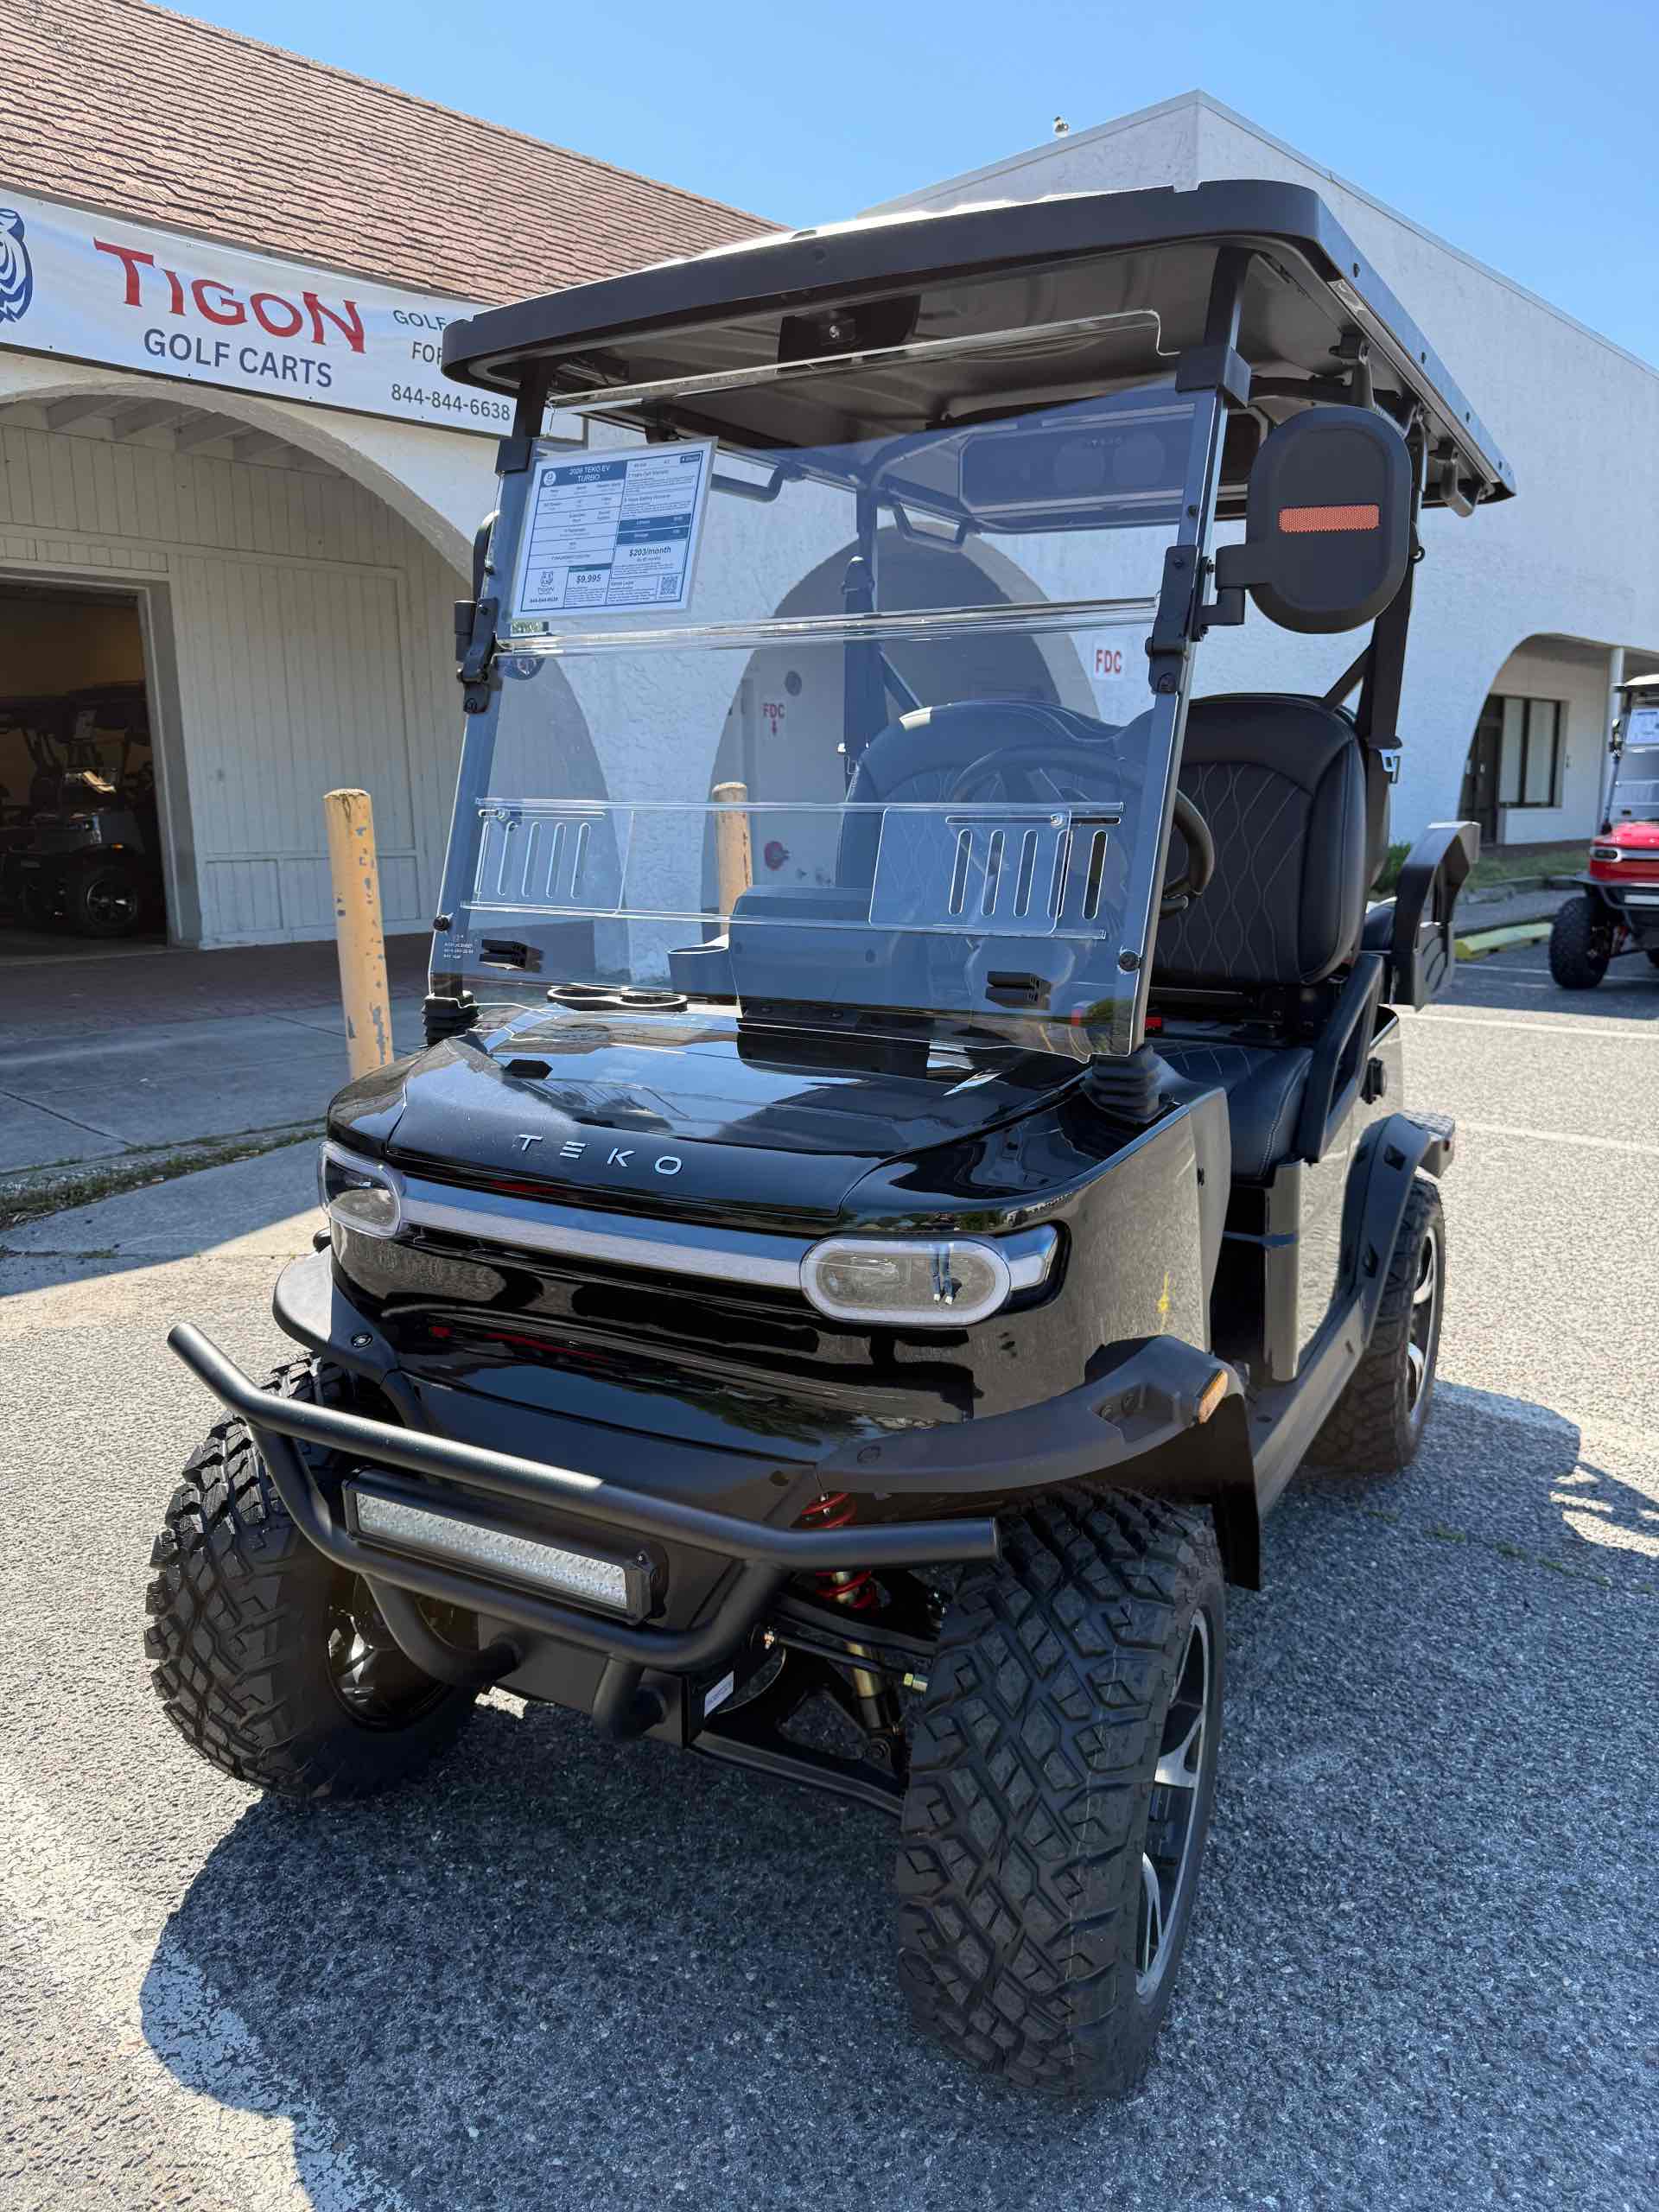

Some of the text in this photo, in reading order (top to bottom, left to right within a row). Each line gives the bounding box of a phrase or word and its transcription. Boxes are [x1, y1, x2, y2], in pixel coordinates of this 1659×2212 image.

[92, 237, 366, 354] TIGON
[392, 309, 448, 331] GOLF
[143, 327, 333, 388] GOLF CARTS
[391, 384, 512, 421] 844-844-6638
[1095, 649, 1122, 675] FDC
[763, 702, 785, 719] FDC
[518, 1134, 683, 1176] TEKO
